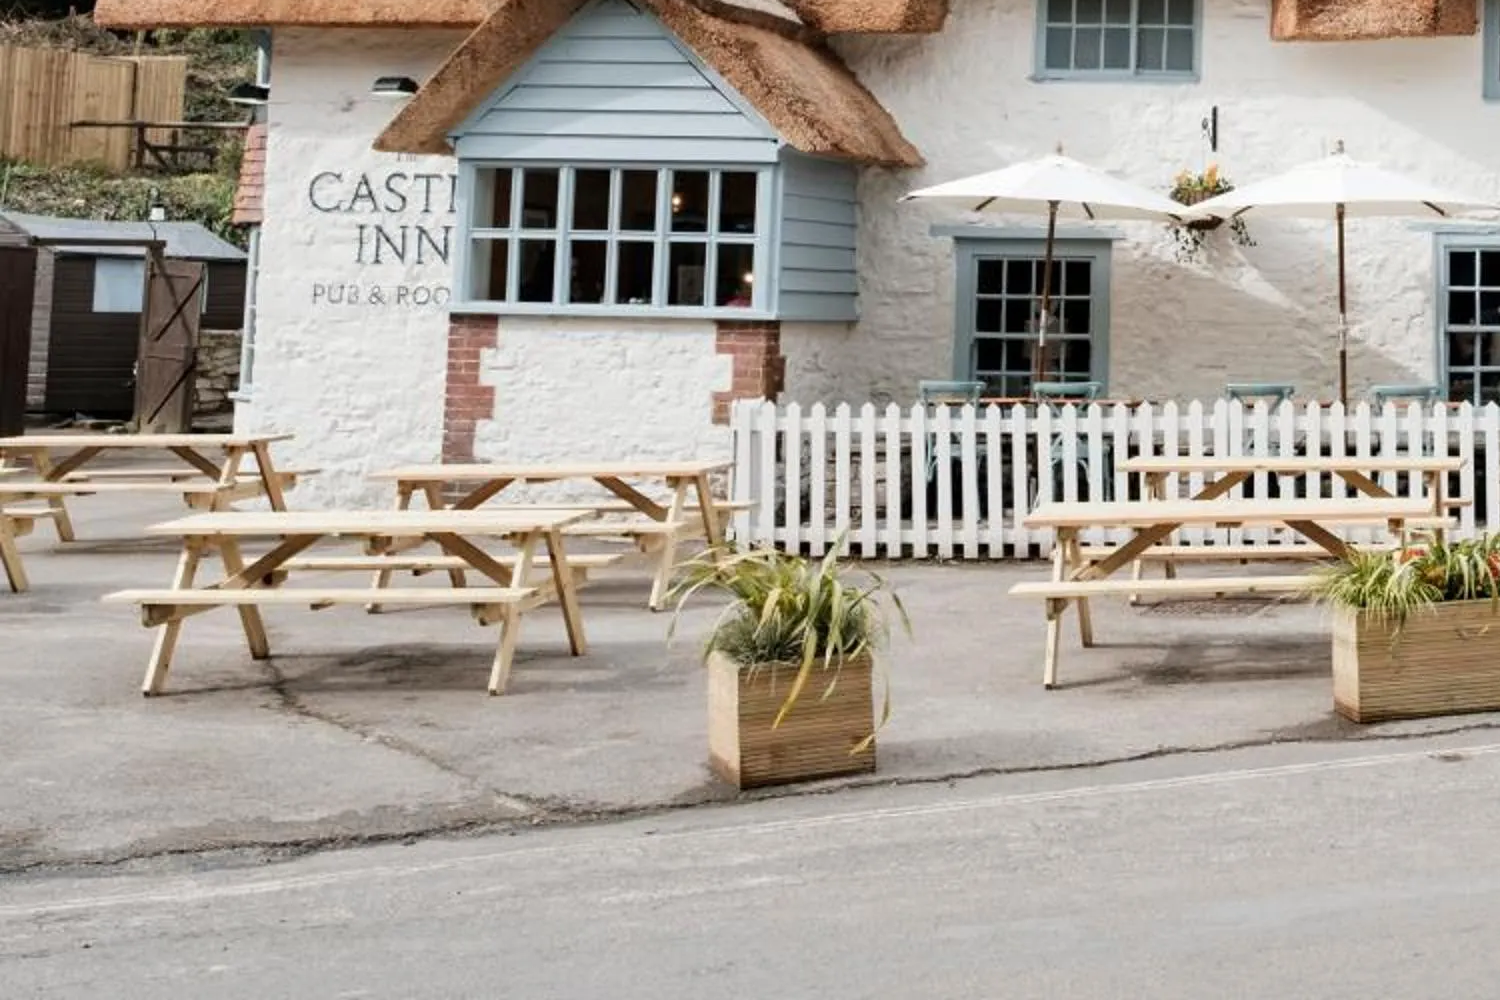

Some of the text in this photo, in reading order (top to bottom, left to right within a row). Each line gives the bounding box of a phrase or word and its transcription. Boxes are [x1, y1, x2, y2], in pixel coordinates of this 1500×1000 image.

[309, 171, 457, 213] CAST
[355, 223, 455, 265] INN
[312, 283, 451, 305] PUB & ROO
